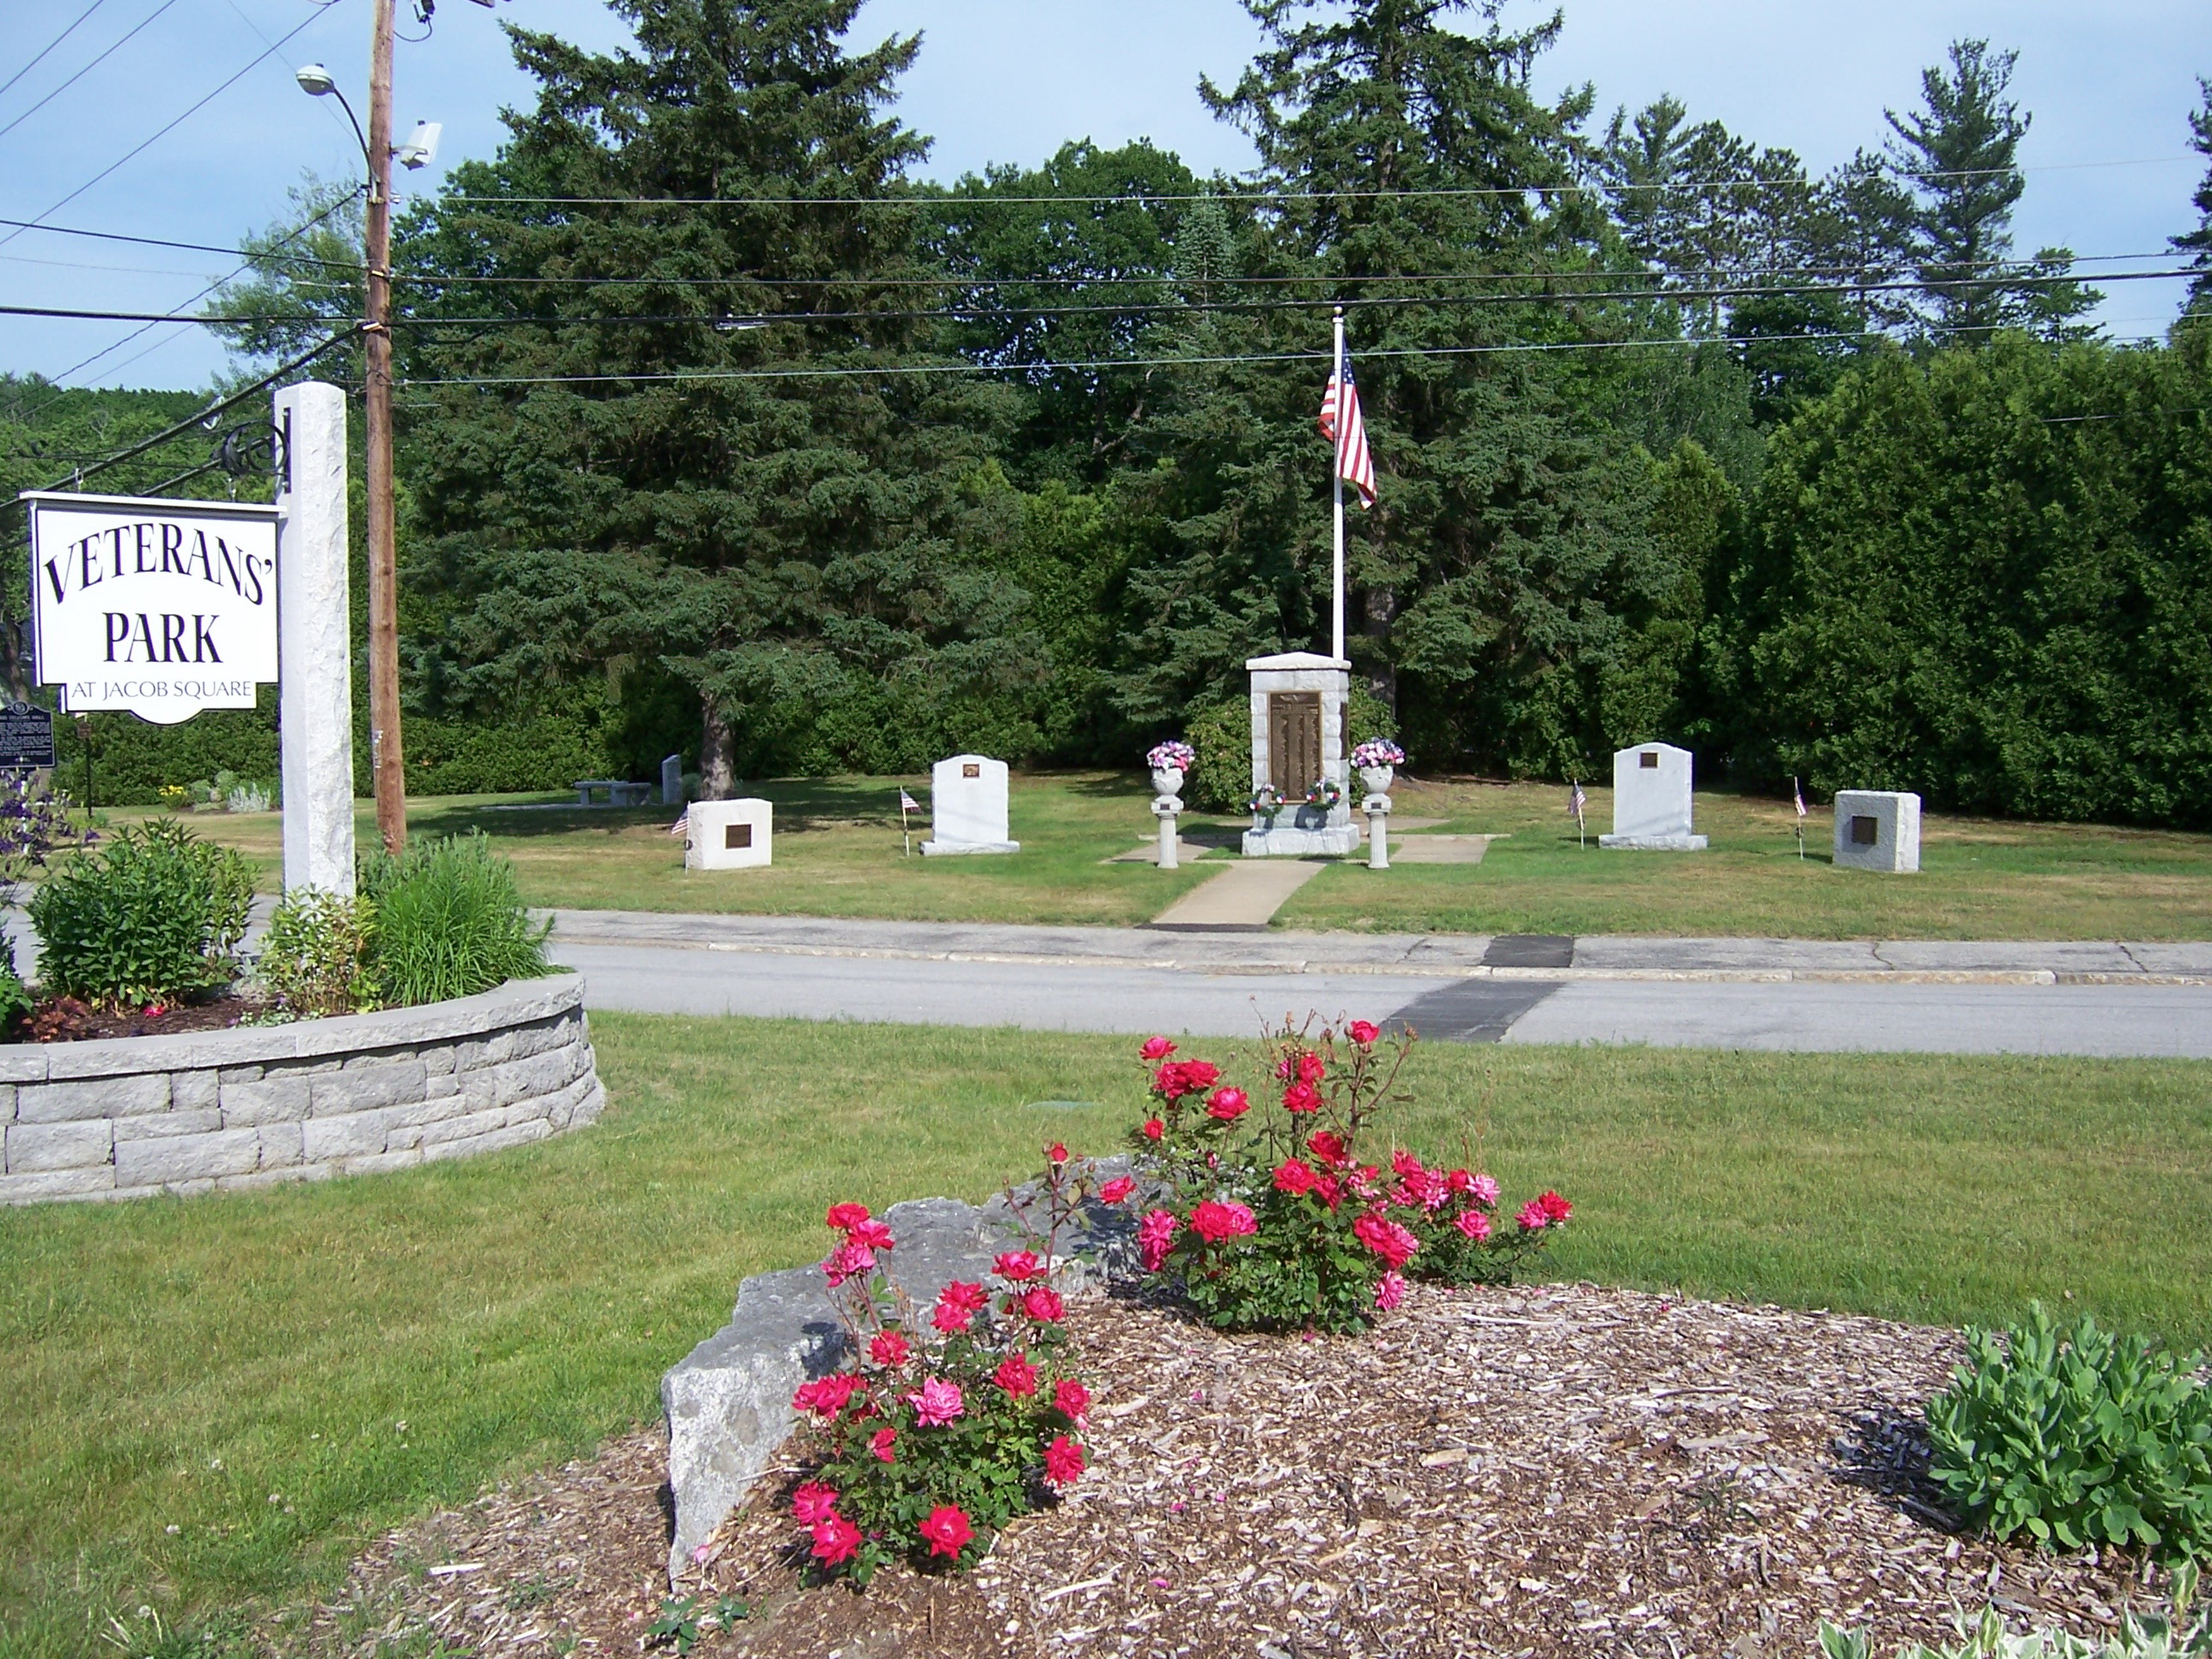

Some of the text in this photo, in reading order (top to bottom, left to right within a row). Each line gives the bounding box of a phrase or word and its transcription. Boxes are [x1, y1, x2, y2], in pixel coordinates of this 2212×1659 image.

[44, 522, 273, 605] VETERANS'
[102, 612, 223, 663] PARK
[72, 681, 252, 701] AT JACOB SQUARE
